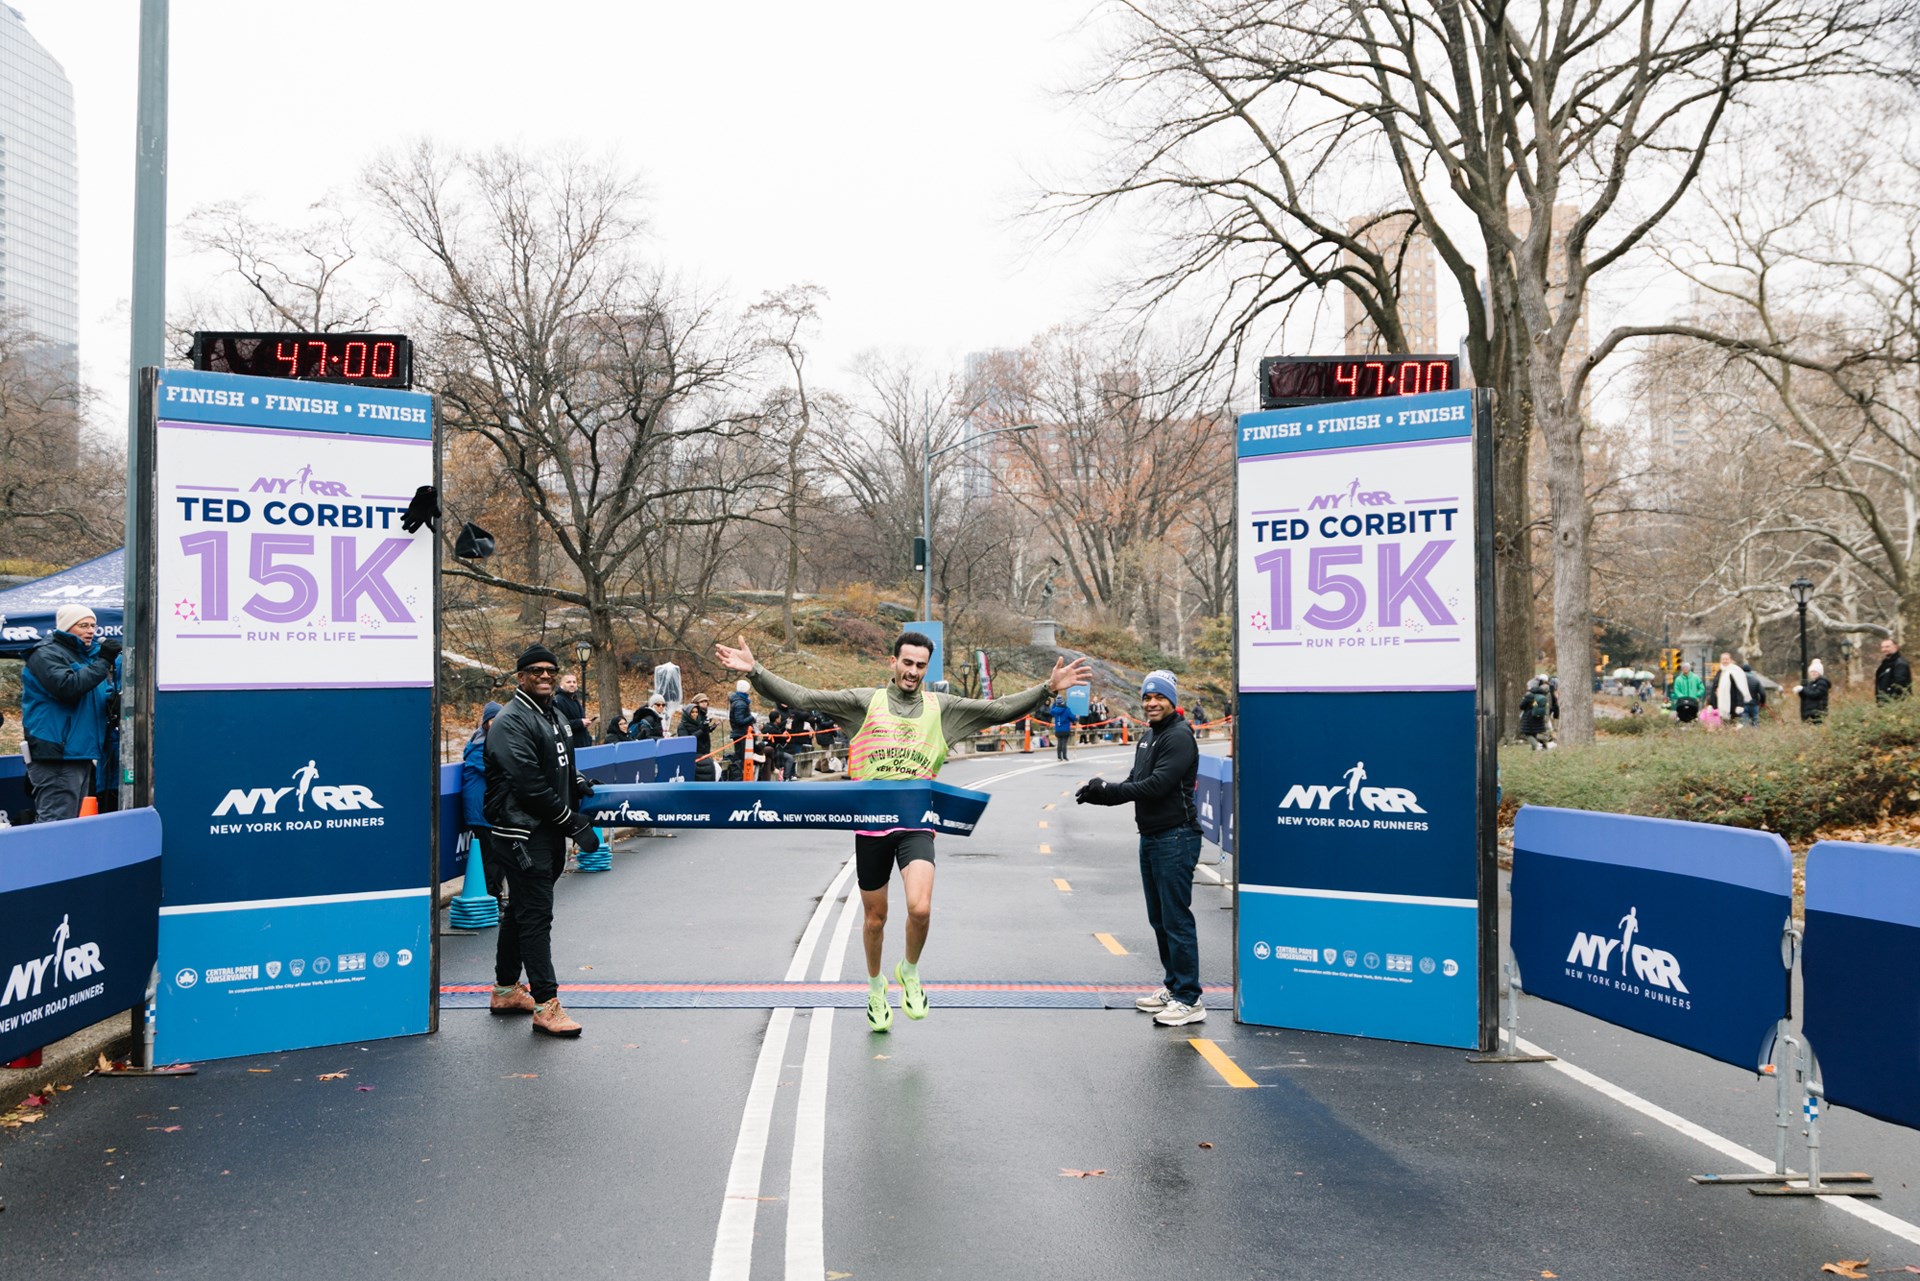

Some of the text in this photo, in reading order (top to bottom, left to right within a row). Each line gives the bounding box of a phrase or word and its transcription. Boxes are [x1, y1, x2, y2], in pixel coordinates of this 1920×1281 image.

[276, 341, 396, 377] 47:00
[1336, 362, 1448, 396] 47:00
[166, 386, 427, 423] FINISH FINISH FINISH
[1242, 405, 1465, 442] FINISH FINISH FINISH
[248, 476, 353, 498] NYRR
[1307, 490, 1397, 511] NYRR
[176, 497, 410, 530] TED CORBIT
[1252, 508, 1458, 543] TED CORBITT
[179, 530, 417, 624] 15K
[1253, 539, 1458, 631] 15K
[95, 625, 124, 637] ORK
[246, 631, 357, 642] RUN FOR LIFE
[1306, 636, 1401, 648] RUN FOR LIFE
[210, 784, 385, 817] NYRR
[1278, 784, 1428, 814] NYRR
[210, 817, 385, 835] NEW YORK ROAD RUNNERS
[594, 810, 711, 822] NYRR RUN FOR LIFE
[728, 810, 899, 824] NYRR NEW YORK ROAD RUNNERS
[1277, 816, 1429, 831] NEW YORK ROAD RUNNERS
[0, 941, 105, 1007] NYRR
[205, 965, 253, 977] CENTRAL PARK
[205, 973, 253, 984] CONSERVANCY
[1566, 931, 1690, 994] NYRR
[1565, 967, 1691, 1010] NEW YORK ROAD RUNNERS
[0, 982, 105, 1034] NEW YORK ROAD RUNNERS
